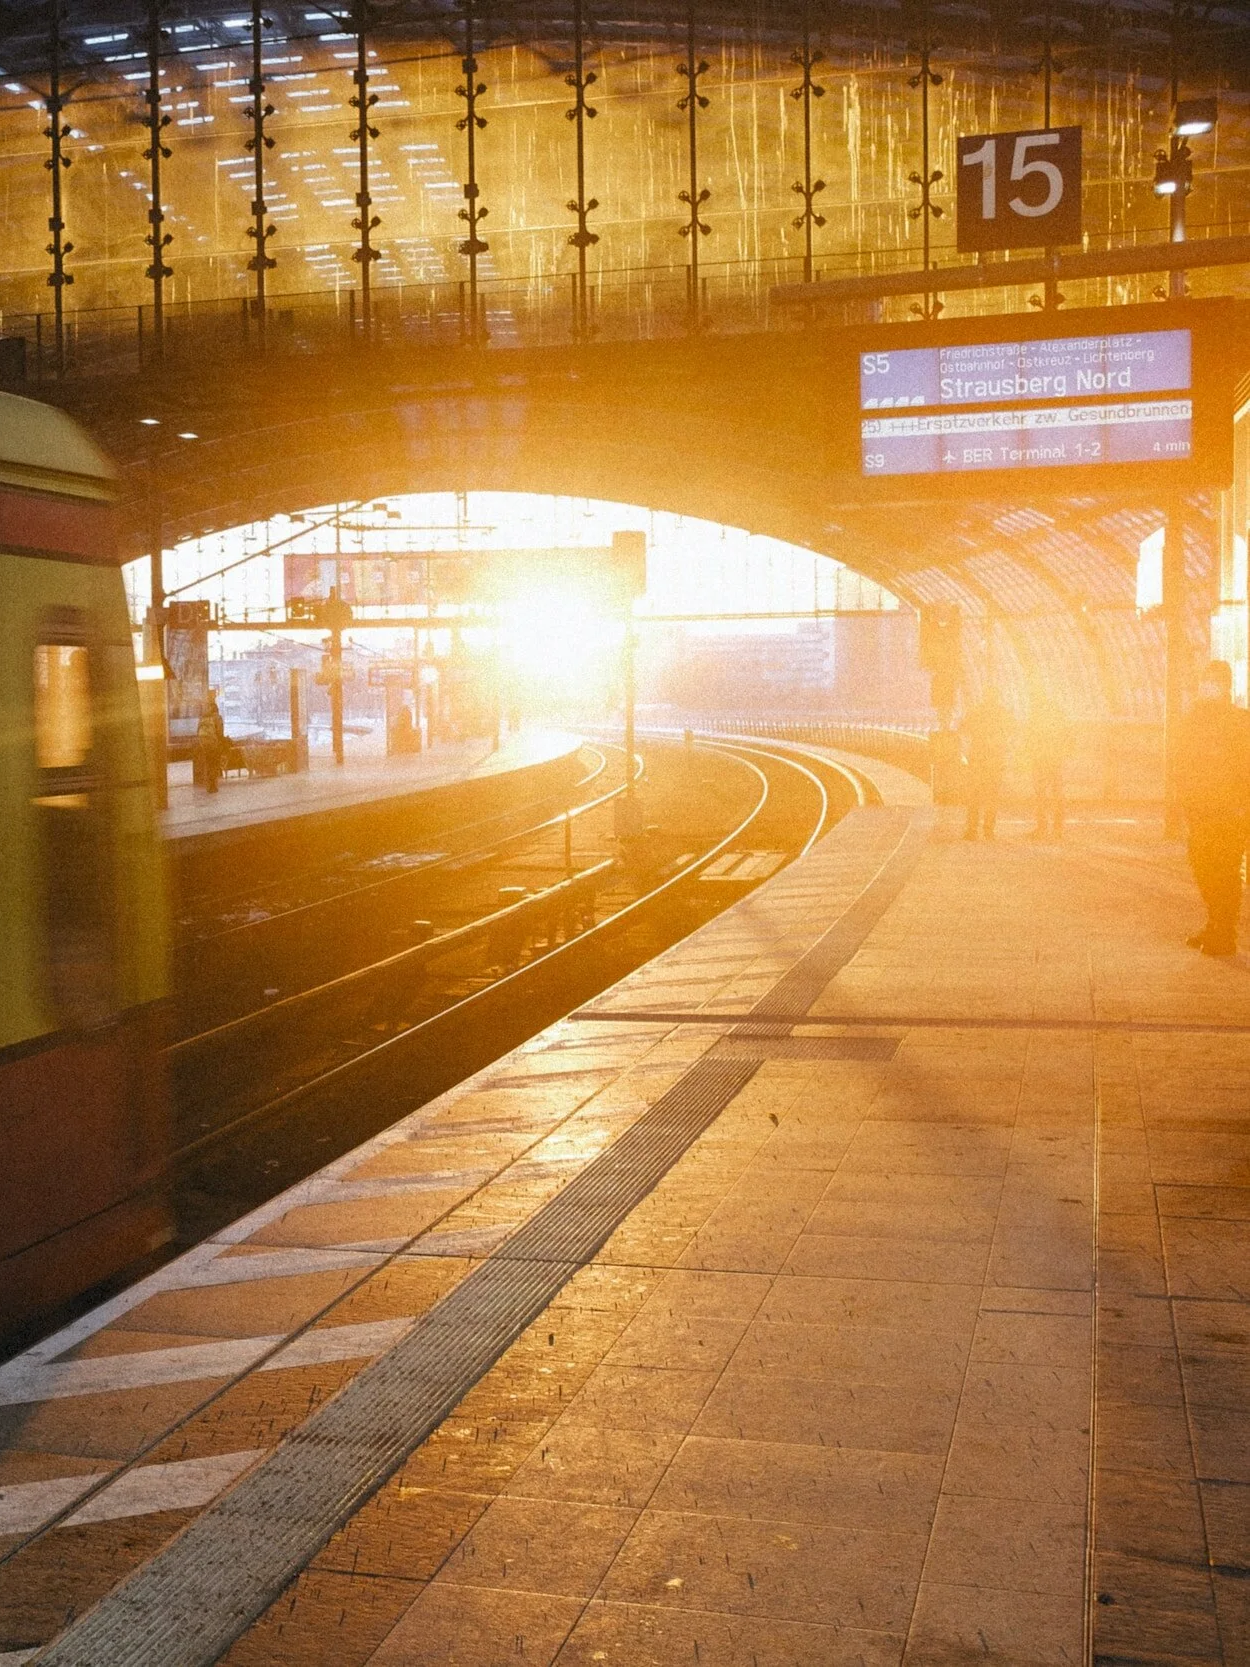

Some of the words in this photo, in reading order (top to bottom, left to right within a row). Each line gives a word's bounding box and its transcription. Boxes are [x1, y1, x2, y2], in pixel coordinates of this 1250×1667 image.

[963, 133, 1063, 219] 15
[940, 345, 1027, 360] Friedrichstraße
[1040, 337, 1132, 353] Alexanderplatz
[940, 359, 1005, 373] Ostbahnhof
[1017, 355, 1071, 368] Ostkreuz
[1084, 349, 1155, 364] Lichtenberg
[863, 354, 890, 375] S5
[940, 374, 1066, 398] Strausberg
[1077, 367, 1131, 391] Nord
[865, 454, 885, 468] S9
[963, 448, 993, 463] BER
[1000, 444, 1066, 461] Terminal
[1075, 442, 1100, 457] 1-2
[1166, 440, 1190, 452] min
